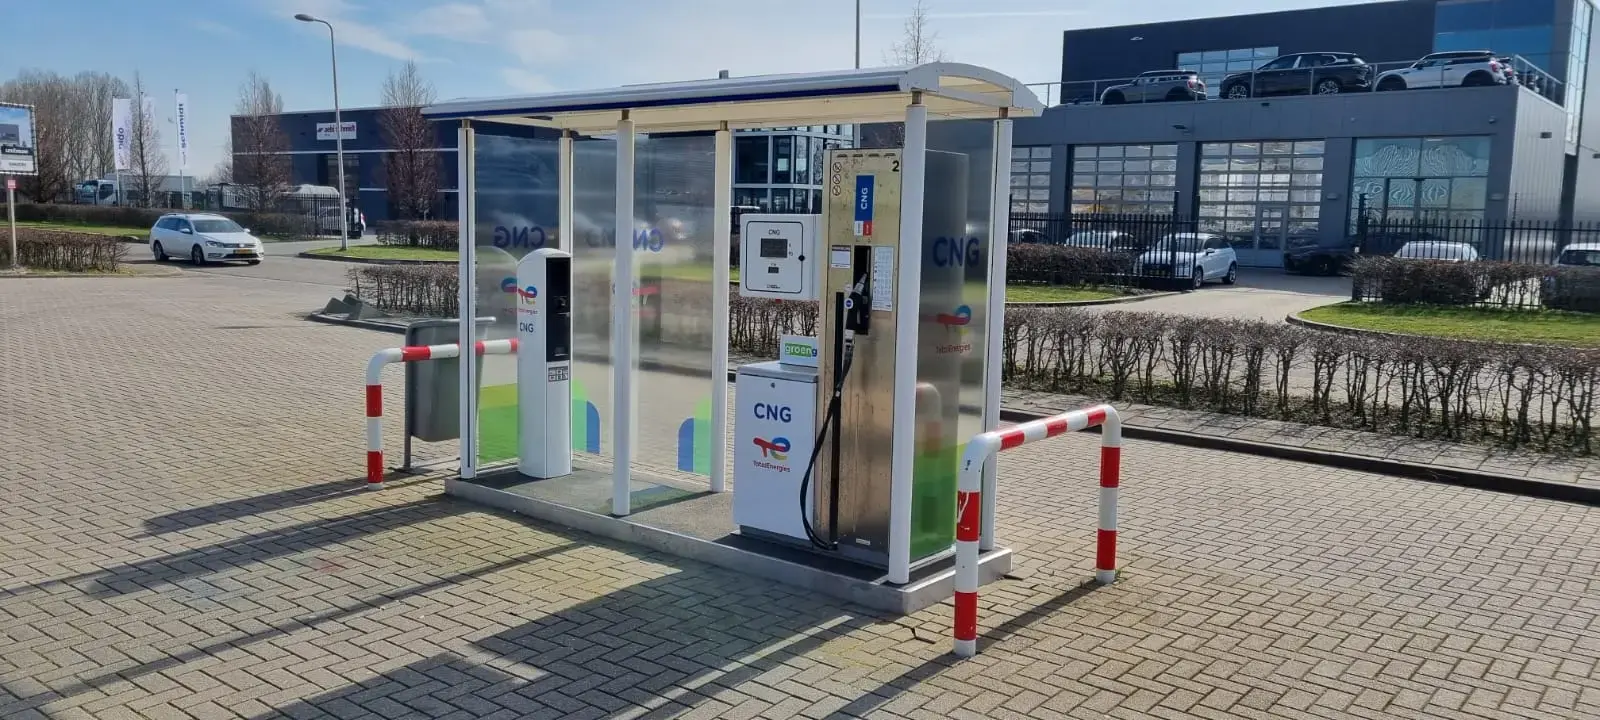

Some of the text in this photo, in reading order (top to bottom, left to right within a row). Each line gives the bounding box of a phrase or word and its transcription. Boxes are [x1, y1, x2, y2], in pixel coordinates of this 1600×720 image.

[892, 160, 900, 172] 2
[860, 187, 869, 210] CNG
[932, 236, 980, 268] CNG
[519, 322, 534, 333] CNG
[785, 344, 817, 357] groeng
[753, 402, 792, 423] CNG
[753, 460, 791, 473] TotalEnergies
